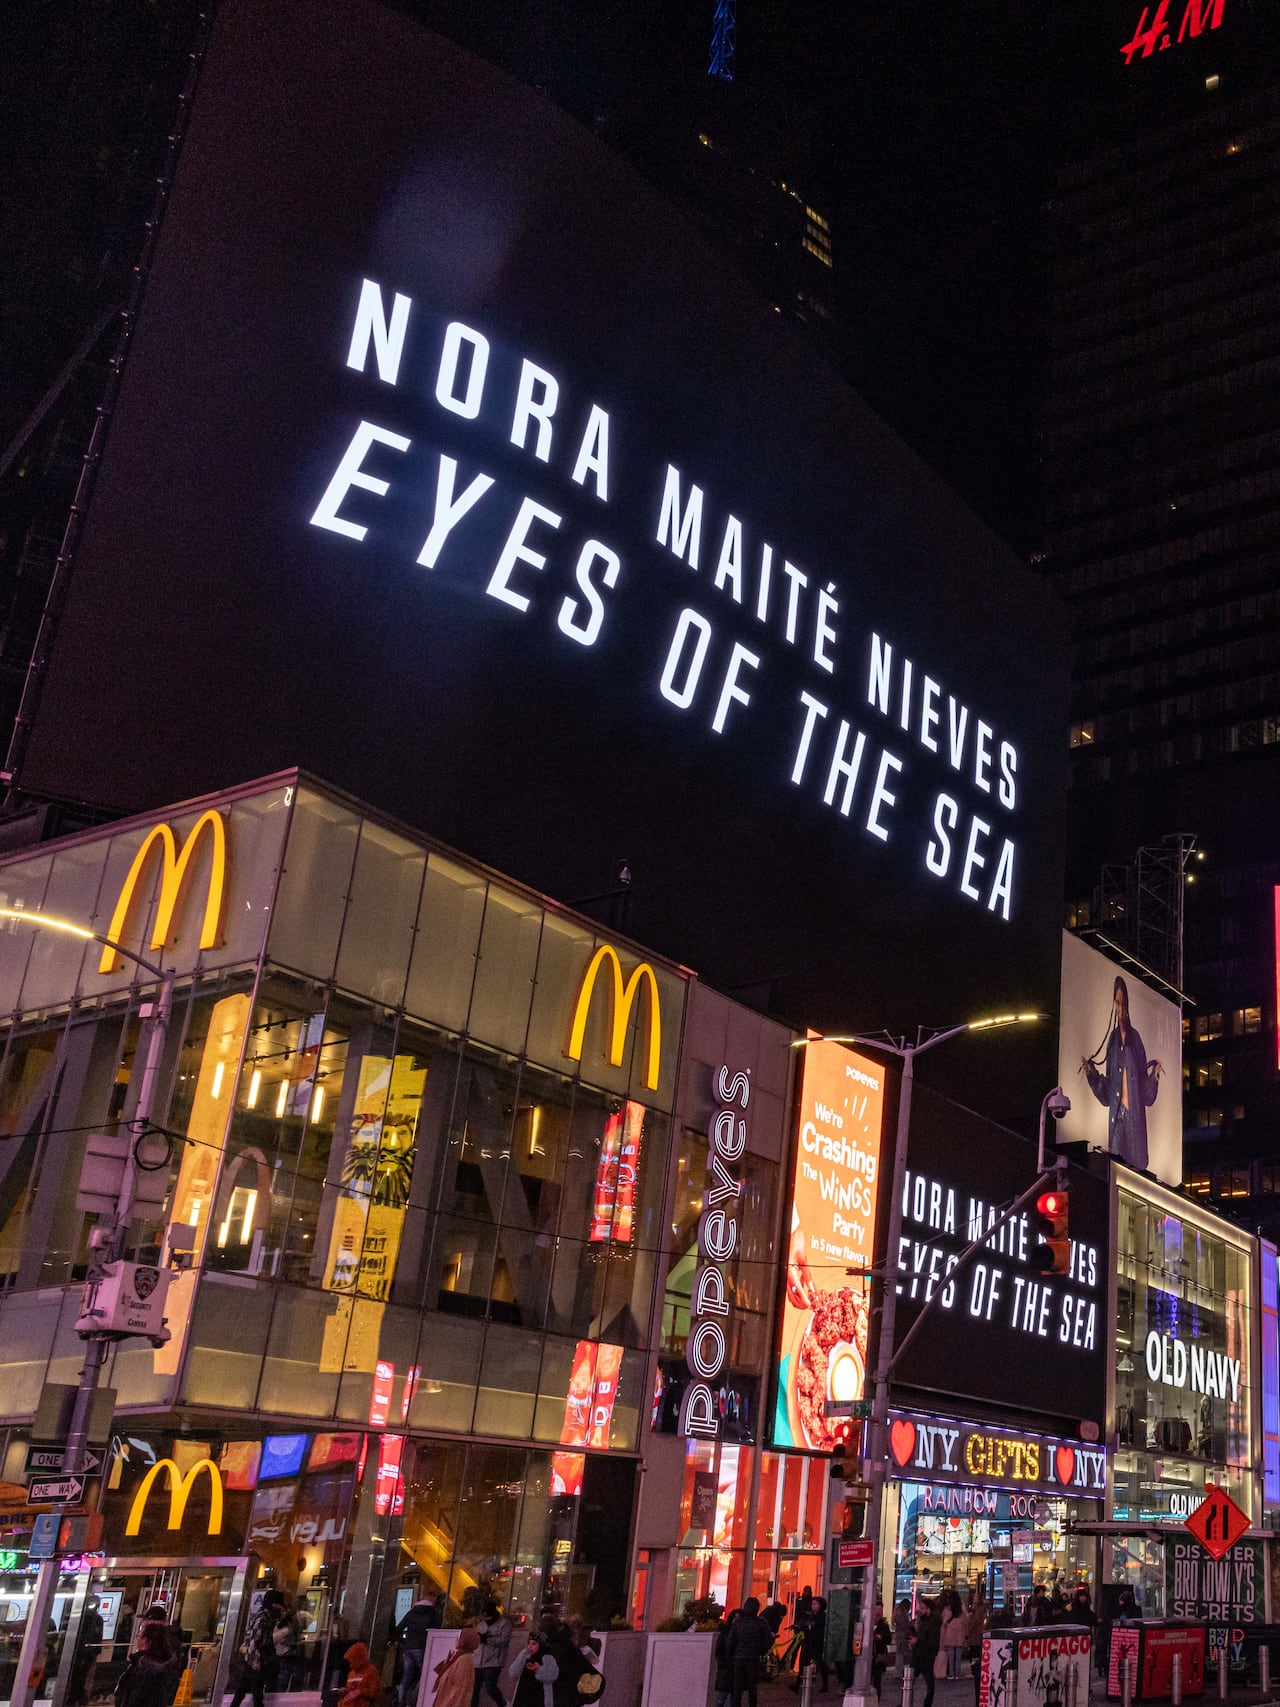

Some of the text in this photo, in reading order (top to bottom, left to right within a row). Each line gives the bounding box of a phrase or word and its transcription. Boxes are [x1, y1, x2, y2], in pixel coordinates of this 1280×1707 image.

[346, 278, 1018, 810] NORA MAITÉ NIEVES
[309, 420, 1015, 921] EYES OF THE SEA
[802, 1122, 877, 1182] Crashing
[802, 1161, 818, 1182] The
[833, 1213, 865, 1245] Party
[968, 1198, 1028, 1261] MAITÉ
[811, 1234, 819, 1250] in
[820, 1238, 825, 1252] 5
[826, 1243, 842, 1256] new
[970, 1264, 1002, 1320] OF
[1011, 1277, 1052, 1337] THE
[1060, 1295, 1097, 1351] SEA
[1145, 1330, 1241, 1403] OLD NAVY
[38, 1455, 61, 1465] ONE
[965, 1432, 1041, 1482] GIFTS
[34, 1483, 76, 1495] ONE WAY
[924, 1486, 998, 1513] RAINBOW
[1170, 1494, 1187, 1513] OLD
[1174, 1545, 1254, 1561] DISVER
[1019, 1634, 1090, 1661] CHICAGO
